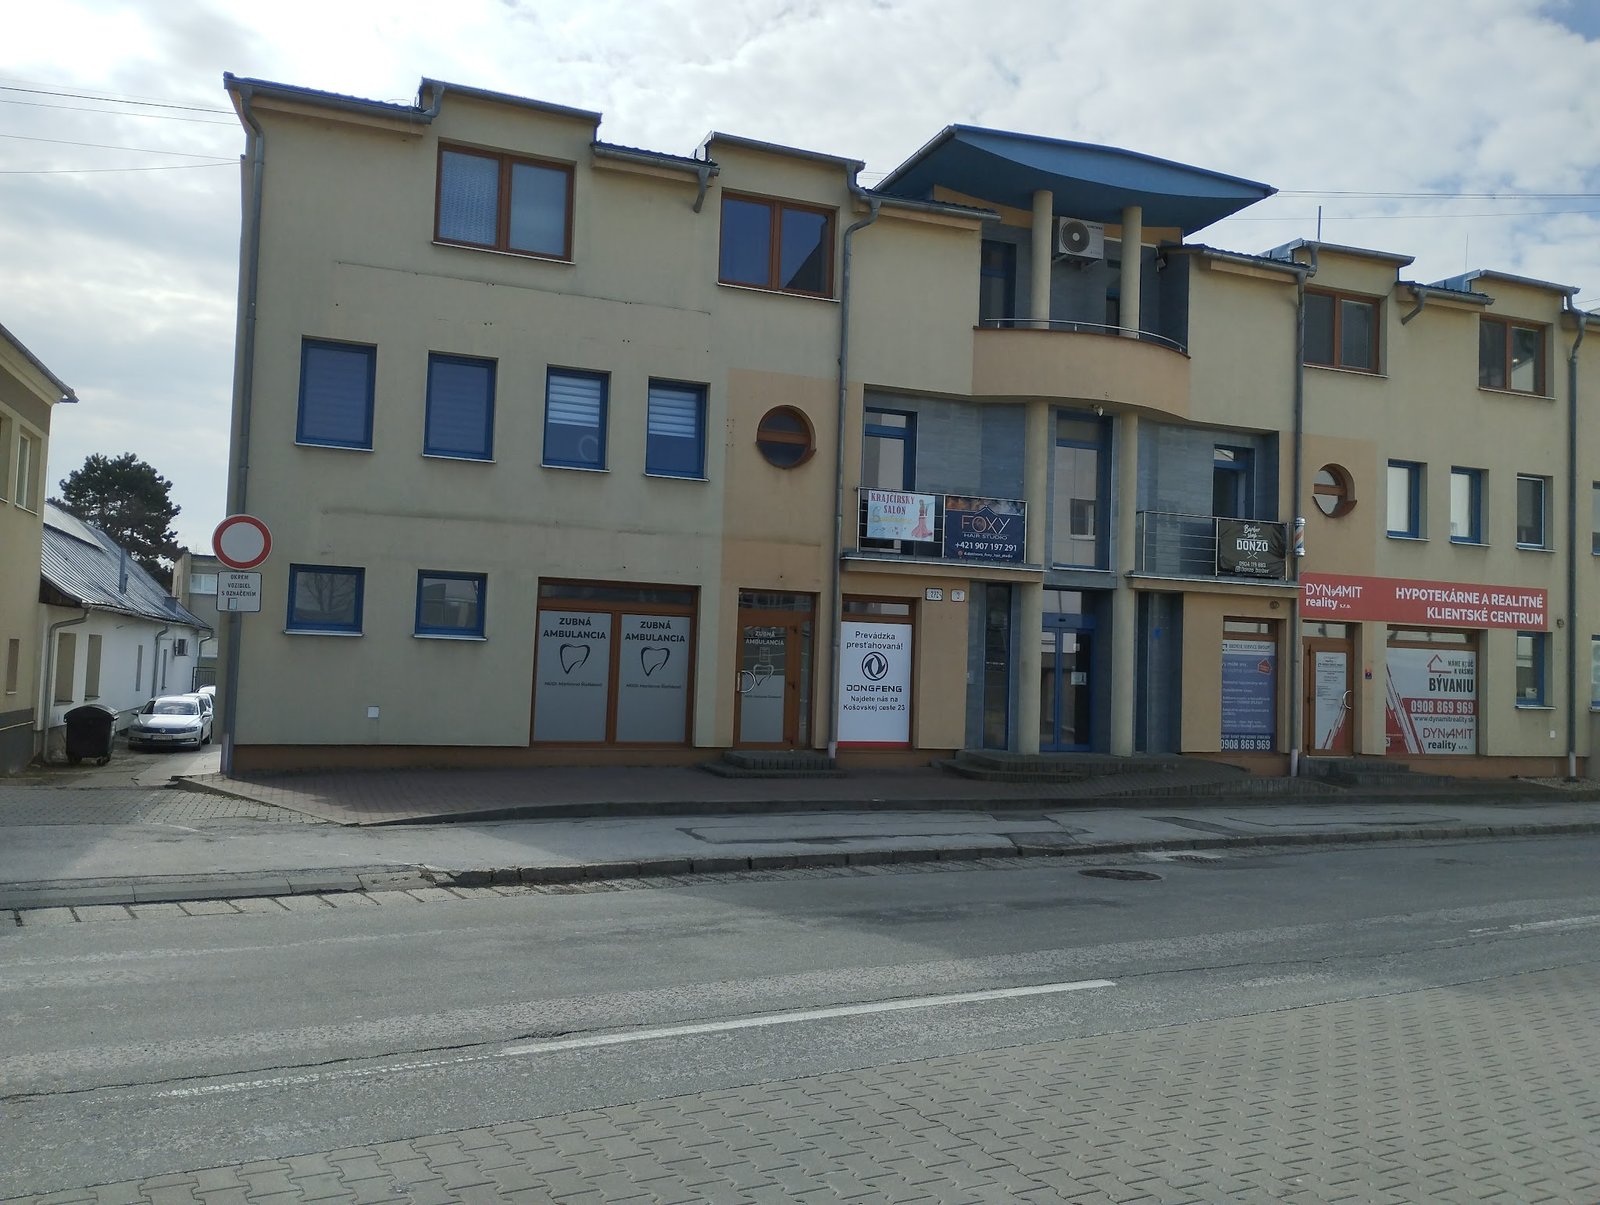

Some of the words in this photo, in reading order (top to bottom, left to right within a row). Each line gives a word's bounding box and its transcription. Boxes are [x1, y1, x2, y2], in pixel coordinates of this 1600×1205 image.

[961, 514, 1011, 534] FOXY
[955, 541, 973, 549] +421
[974, 542, 988, 550] 907
[990, 543, 1003, 551] 197
[1004, 544, 1017, 552] 291
[1236, 539, 1269, 552] DONZO
[1305, 583, 1363, 598] DYNAMIT
[1395, 587, 1480, 604] HYPOTEKÁRNE
[1481, 593, 1489, 605] A
[1491, 594, 1543, 608] REALITNÉ
[1305, 597, 1338, 610] reality
[1426, 606, 1488, 622] KLIENTSKÉ
[1490, 611, 1543, 625] CENTRUM
[559, 616, 592, 626] ZUBNÁ
[640, 620, 671, 630] ZUBNÁ
[543, 629, 607, 640] AMBULANCIA
[624, 633, 686, 643] AMBULANCIA
[855, 630, 896, 640] Prevádzka
[745, 638, 784, 646] AMBULANCIA
[846, 641, 904, 650] presťahovaná!
[846, 684, 902, 692] DONGFENG
[1429, 674, 1473, 692] BÝVANIU
[843, 704, 877, 712] Košovskej
[1411, 700, 1434, 713] 0908
[1436, 701, 1454, 713] 869
[1456, 701, 1474, 714] 969
[1422, 727, 1474, 739] DYNAMIT
[1240, 740, 1255, 750] 869
[1256, 740, 1270, 750] 969
[1428, 740, 1457, 752] reality
